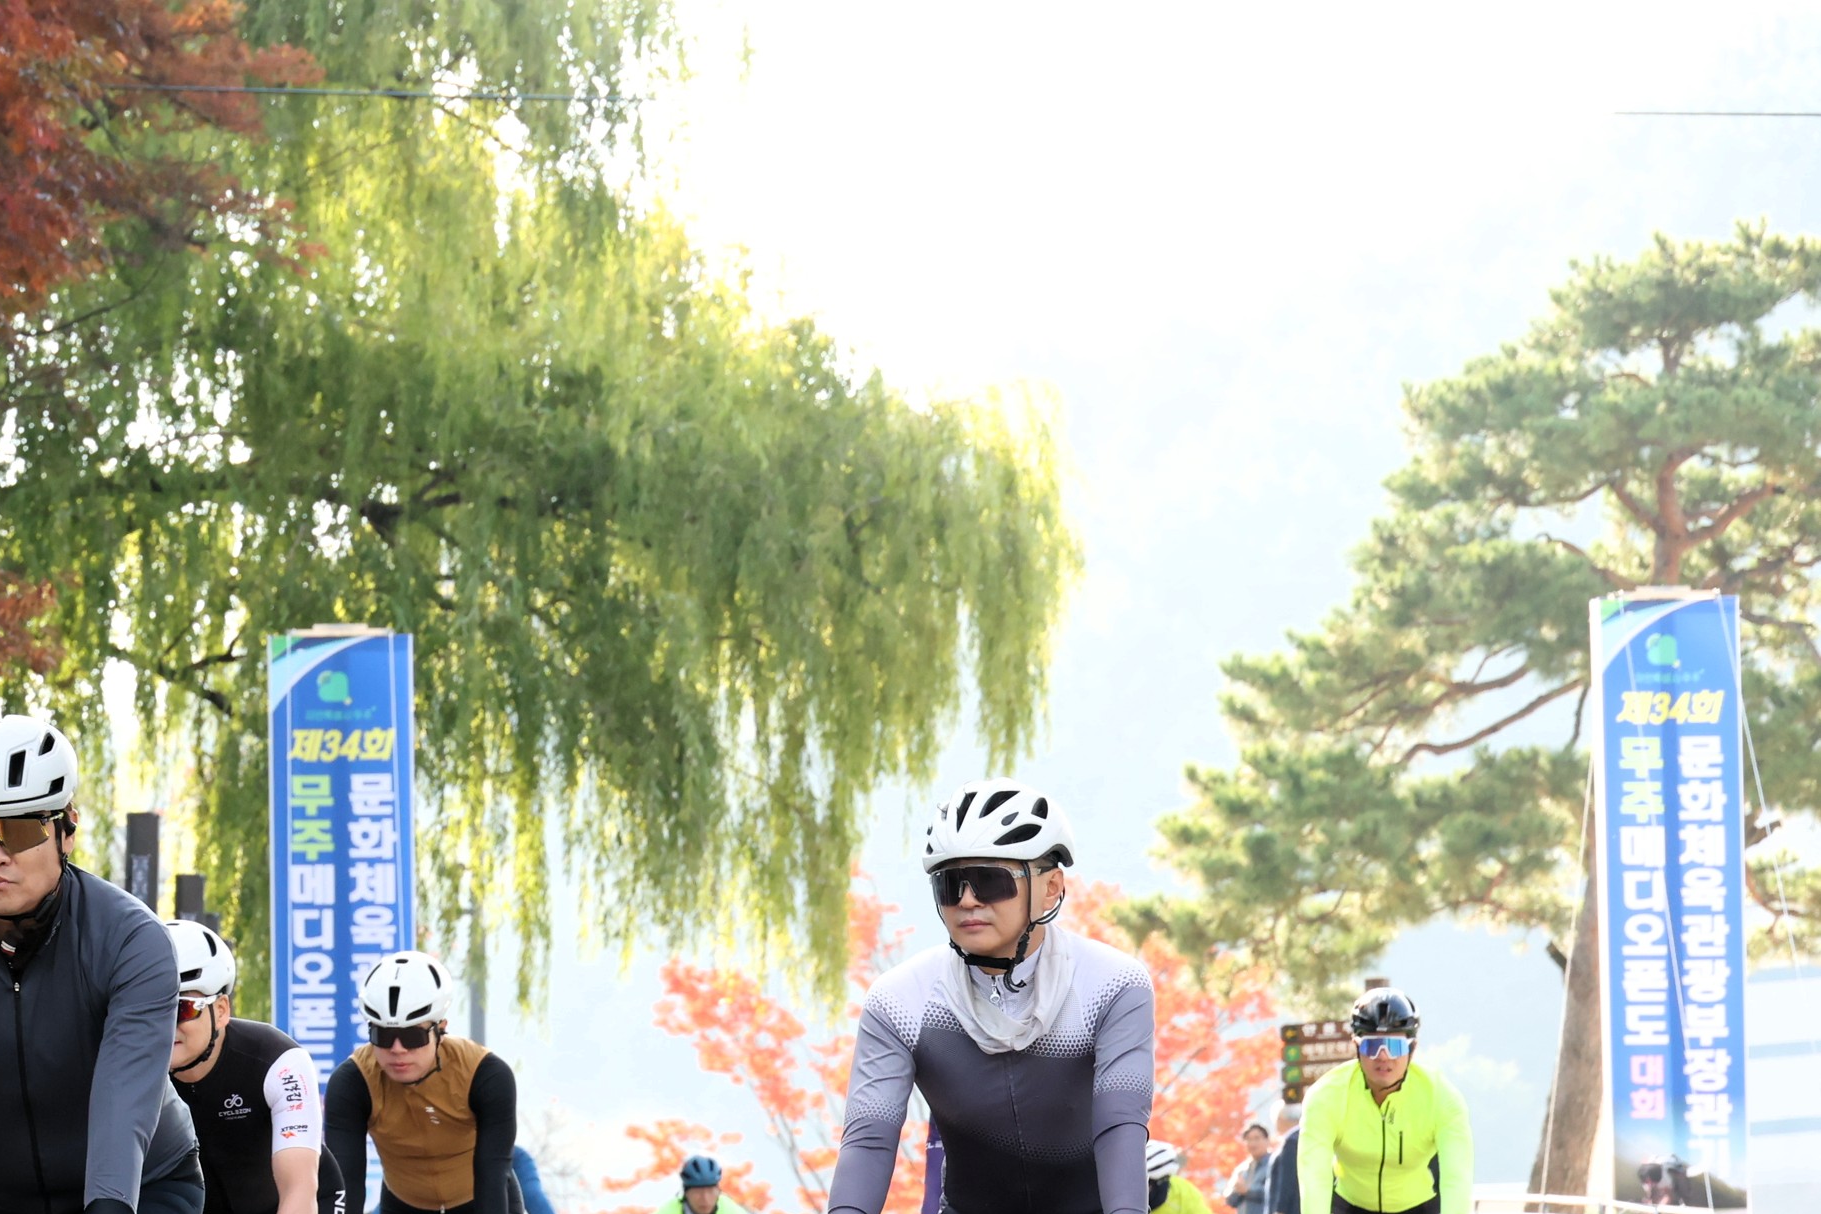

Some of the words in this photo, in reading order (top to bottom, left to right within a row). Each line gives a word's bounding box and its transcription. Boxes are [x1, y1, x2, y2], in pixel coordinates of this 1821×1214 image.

[1616, 689, 1725, 725] 제34회
[289, 727, 396, 762] 제34회
[1630, 1054, 1667, 1119] 대회
